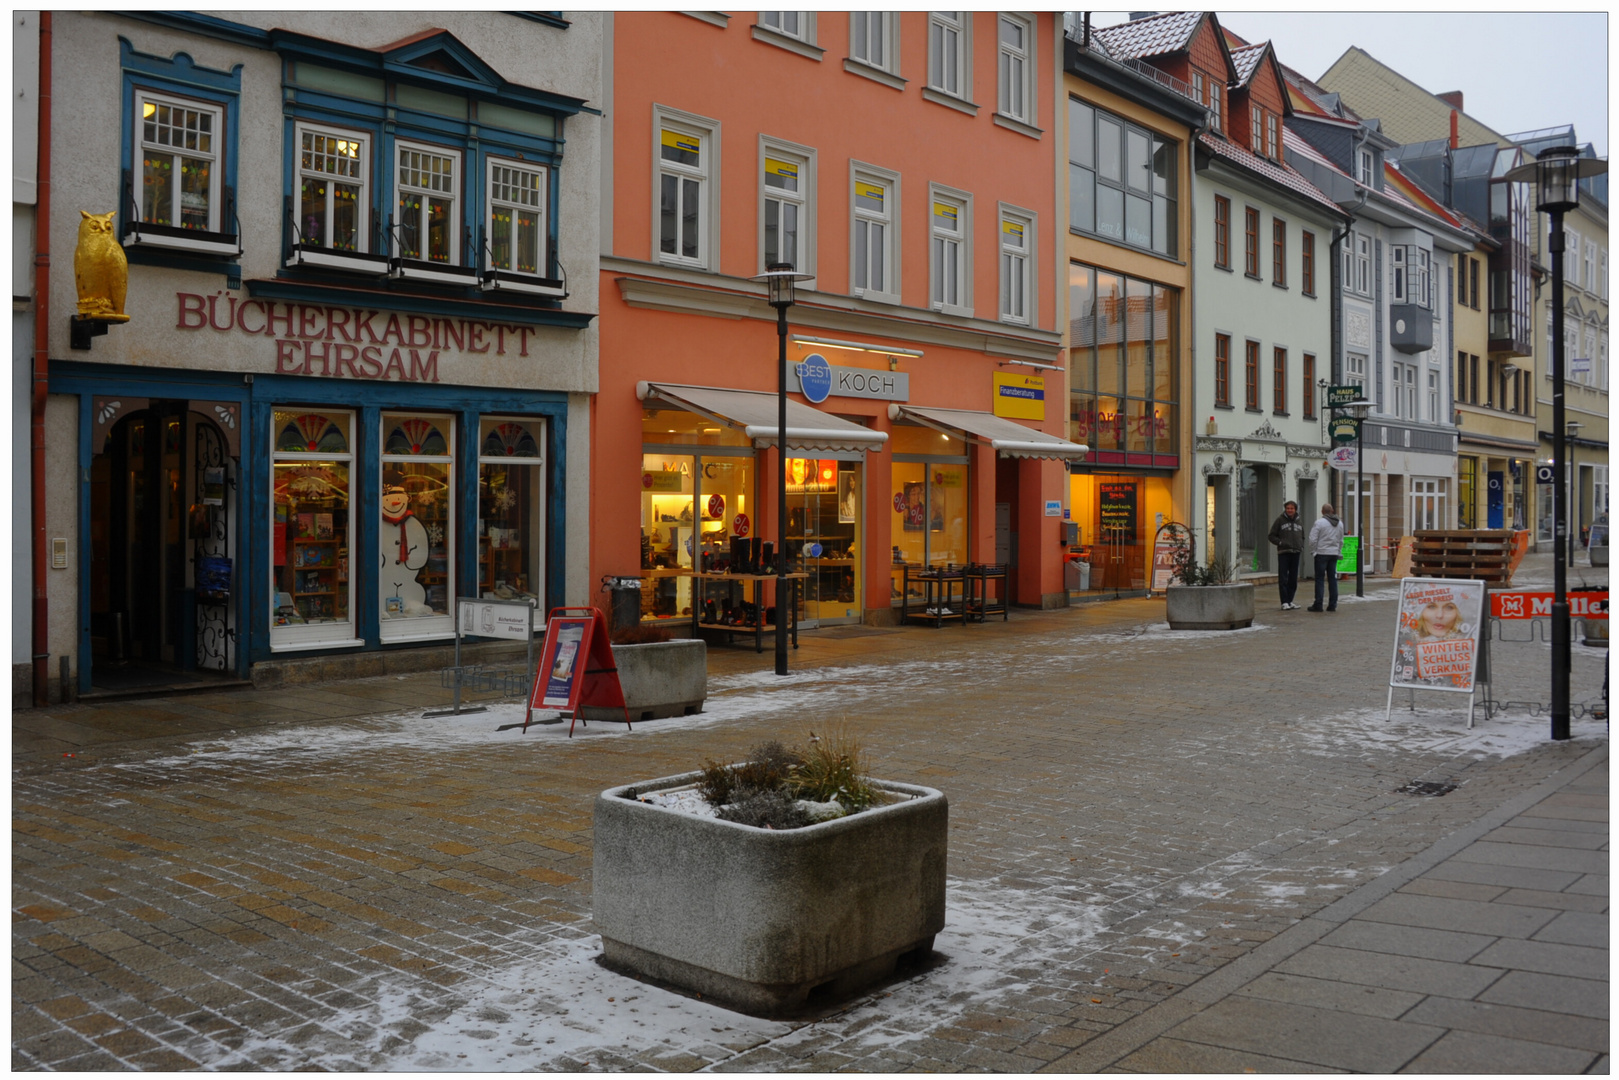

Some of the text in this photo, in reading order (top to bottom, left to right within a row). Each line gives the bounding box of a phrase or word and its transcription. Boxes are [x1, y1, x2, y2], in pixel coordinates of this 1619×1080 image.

[176, 290, 535, 357] BÜCHERKABINETT
[275, 339, 440, 382] EHRSAM
[796, 362, 831, 378] BEST
[838, 371, 896, 394] KOCH
[1000, 386, 1035, 399] Finanzberatung
[1078, 408, 1123, 441] georg
[1332, 418, 1359, 427] PENSION
[1425, 588, 1450, 597] RIESELT
[1418, 597, 1432, 605] DER
[1531, 597, 1609, 615] Mlle
[1422, 642, 1469, 654] WINTER
[1422, 652, 1471, 665] SCHLUSS
[1424, 663, 1471, 674] VERKAUF
